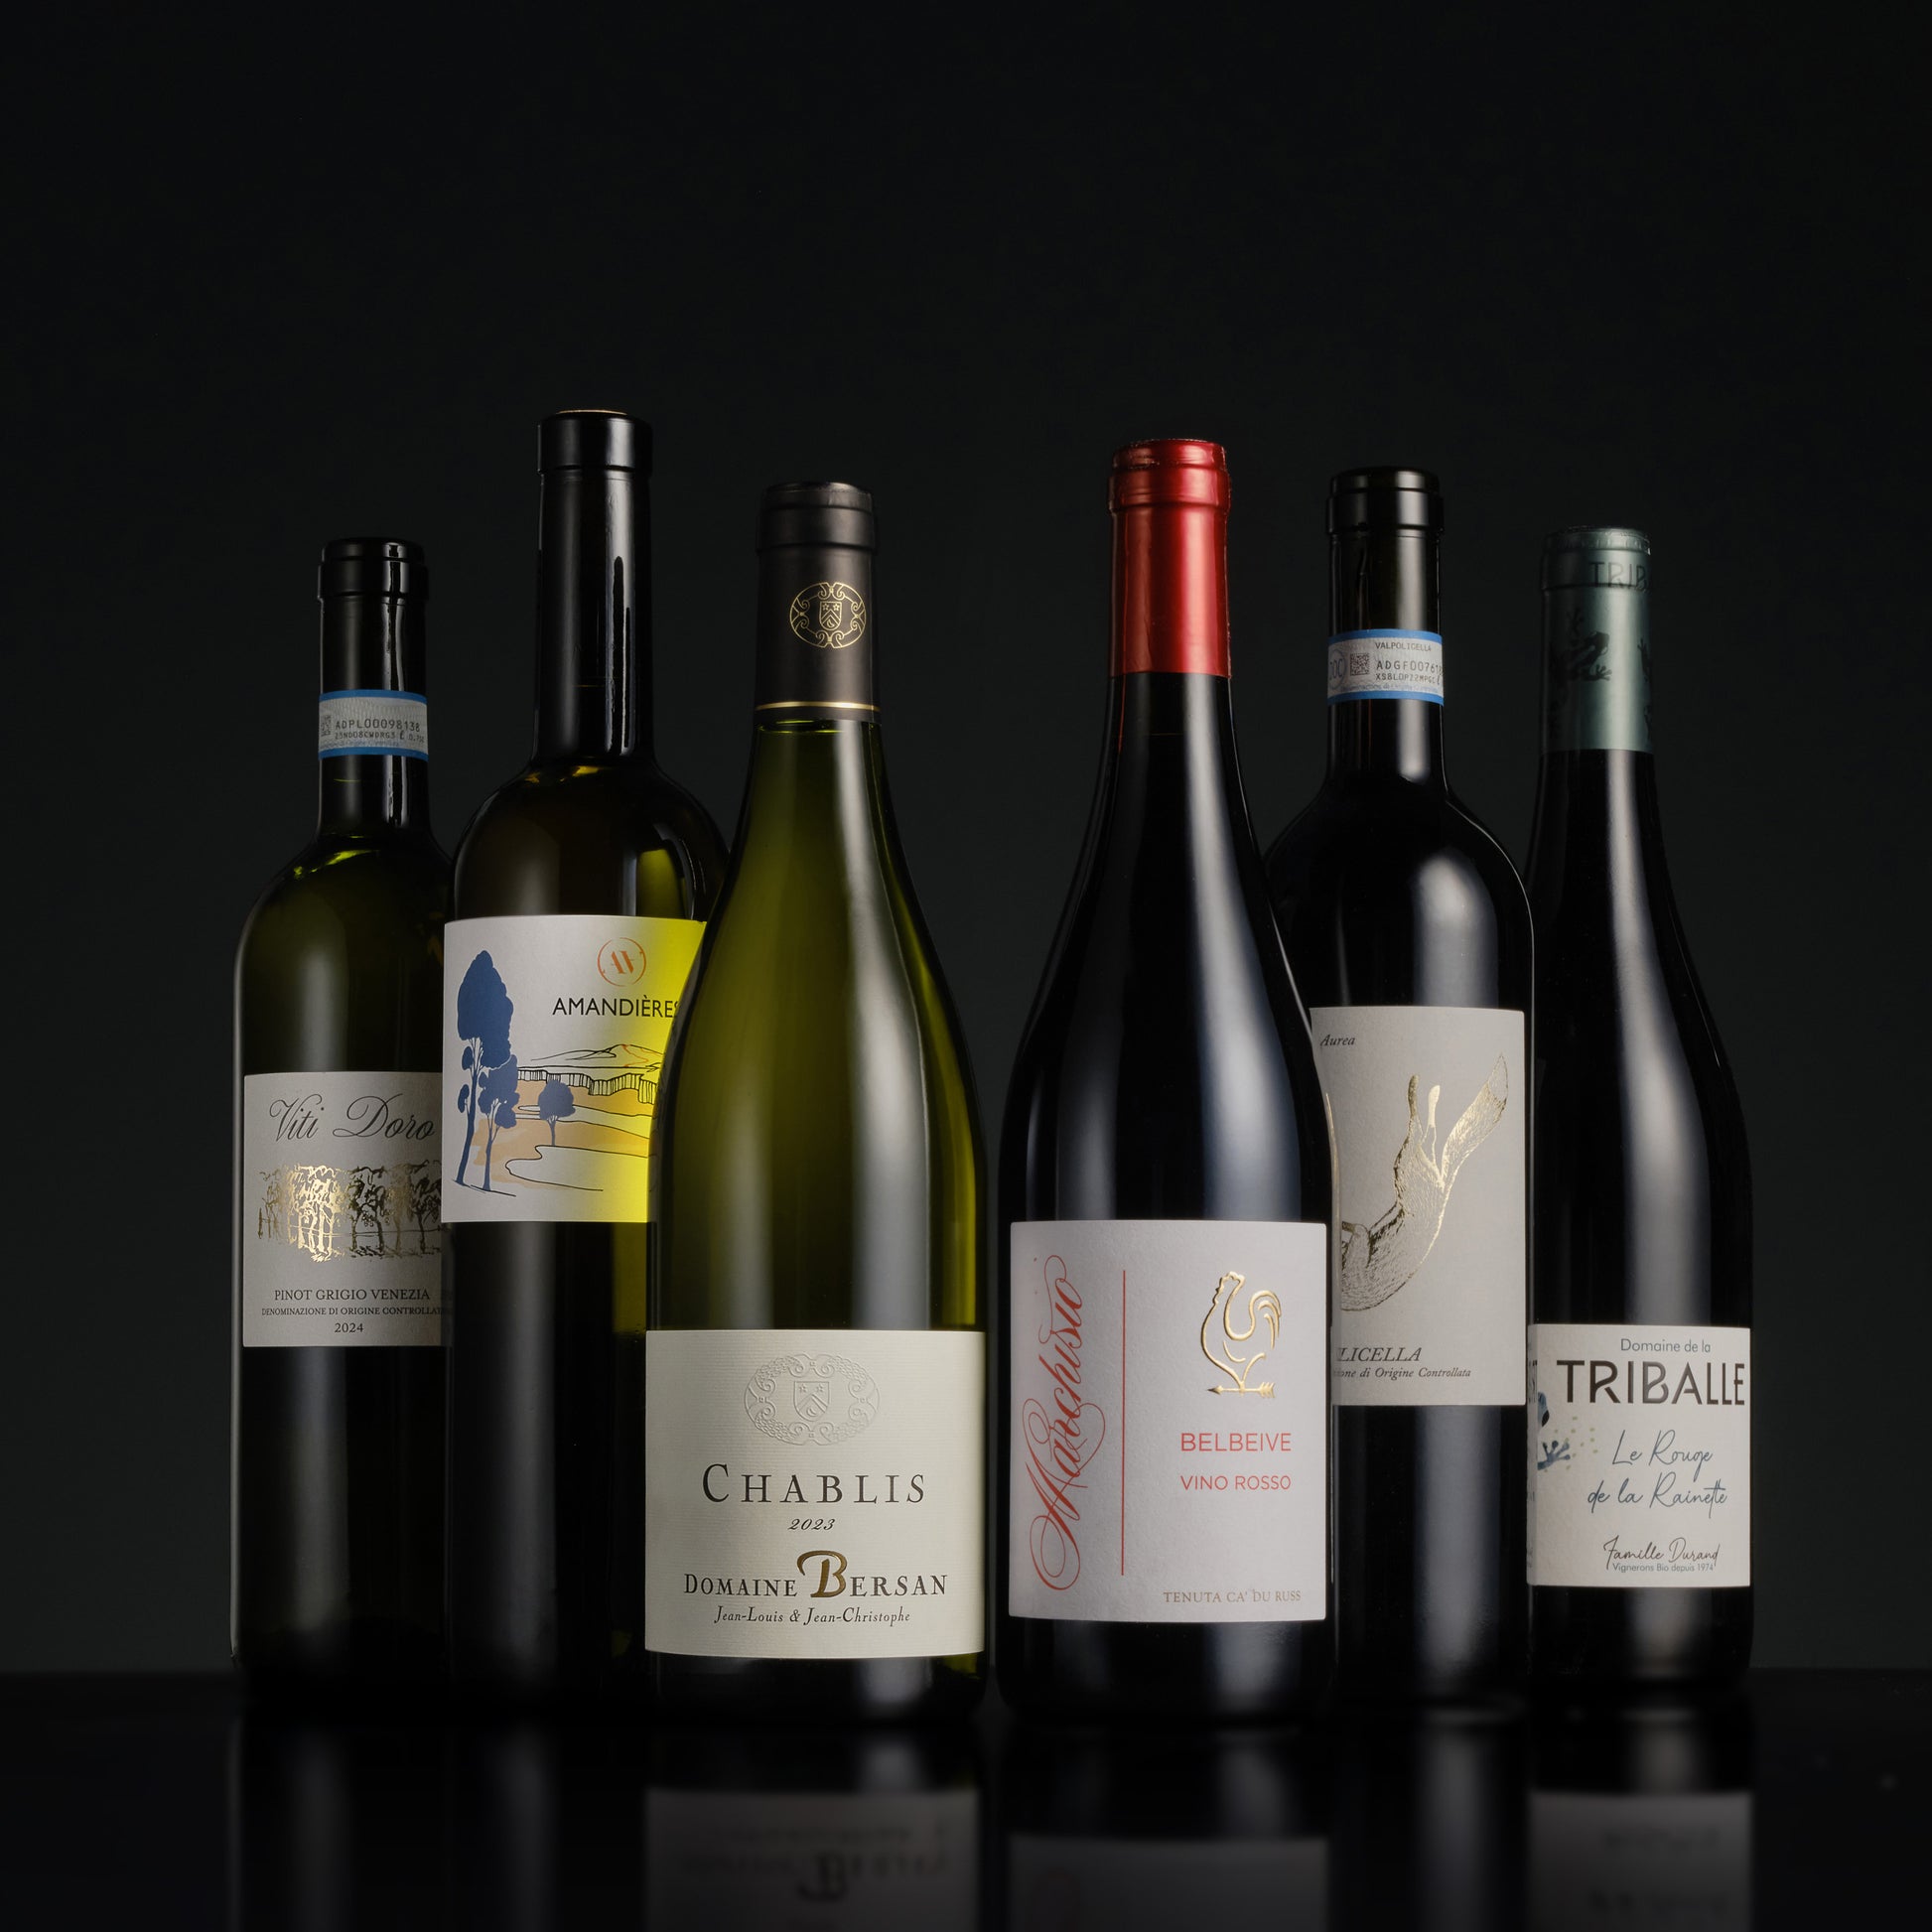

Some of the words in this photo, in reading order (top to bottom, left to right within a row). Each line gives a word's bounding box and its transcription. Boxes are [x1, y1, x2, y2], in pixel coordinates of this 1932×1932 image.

[1375, 641, 1432, 652] VALPOLICELLA
[335, 718, 421, 733] ADPL00098138
[1319, 1034, 1355, 1047] Aurea
[269, 1093, 325, 1143] Viti
[333, 1093, 435, 1141] Doro
[274, 1290, 312, 1301] PINOT
[316, 1290, 367, 1301] GRIGIO
[370, 1289, 430, 1301] VENEZIA
[261, 1307, 327, 1315] DENOMINAZIONE
[382, 1307, 443, 1316] CONTROLLAT
[335, 1322, 364, 1333] 2024
[1620, 1339, 1681, 1353] Domaine
[1684, 1339, 1699, 1353] de
[1702, 1340, 1712, 1353] la
[1336, 1347, 1423, 1362] LICELLA
[1359, 1367, 1372, 1378] di
[1374, 1367, 1415, 1381] Origine
[1418, 1367, 1471, 1378] Controllata
[1557, 1360, 1745, 1405] TRIBALLE
[1180, 1433, 1292, 1452] BELBEIVE
[1612, 1430, 1643, 1465] Le
[1648, 1430, 1715, 1482] Rouge
[702, 1463, 924, 1504] CHABLIS
[1180, 1475, 1228, 1490] VINO
[1234, 1475, 1292, 1490] ROSSO
[1587, 1480, 1610, 1514] de
[1617, 1478, 1644, 1504] la
[1649, 1471, 1728, 1519] Rainette
[787, 1518, 836, 1531] 2023
[1602, 1535, 1665, 1570] Famille
[1668, 1537, 1721, 1568] Durand
[683, 1573, 798, 1597] DOMAINE
[796, 1550, 948, 1598] BERSAN
[1611, 1563, 1655, 1574] Vignerons
[1656, 1563, 1670, 1572] Bio
[1671, 1563, 1696, 1574] depuis
[1697, 1563, 1715, 1572] 1974
[1164, 1591, 1222, 1603] TENUTA
[1252, 1589, 1271, 1602] DU
[1275, 1589, 1302, 1601] RUSS
[714, 1604, 784, 1624] Jean-Louis
[789, 1609, 801, 1623] &
[803, 1605, 911, 1627] Jean-Christophe
